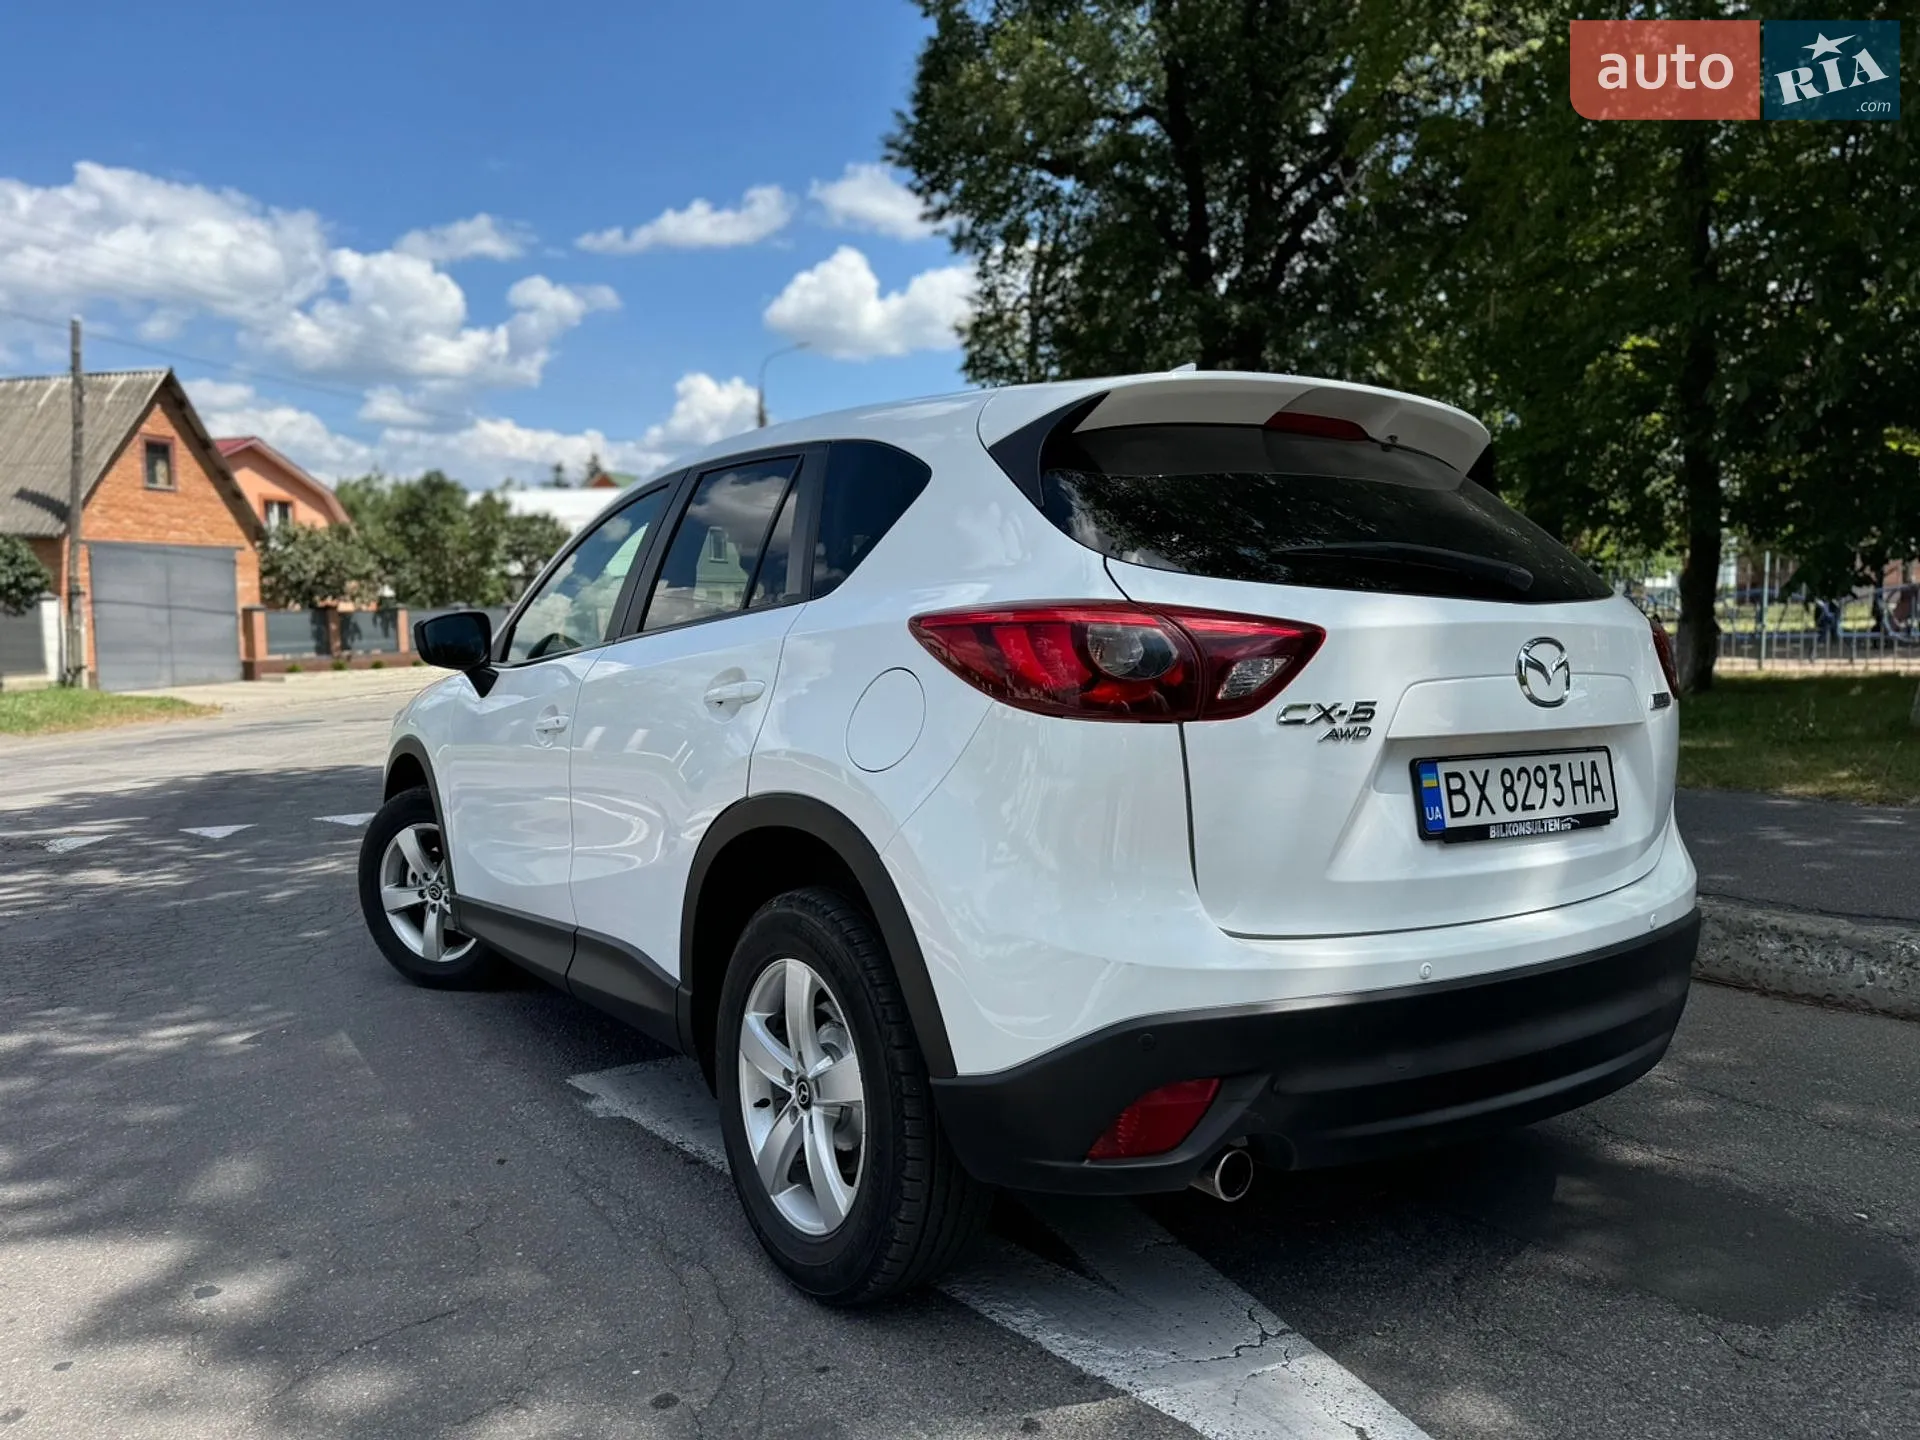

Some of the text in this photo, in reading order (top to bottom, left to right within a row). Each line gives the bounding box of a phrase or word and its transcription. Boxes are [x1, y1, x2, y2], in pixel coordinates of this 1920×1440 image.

[1277, 700, 1378, 725] CX-5
[1317, 726, 1372, 743] AWD
[1444, 760, 1606, 818] BX 8293 HA
[1426, 806, 1442, 821] UA
[1489, 818, 1560, 839] BILKONSULTEN
